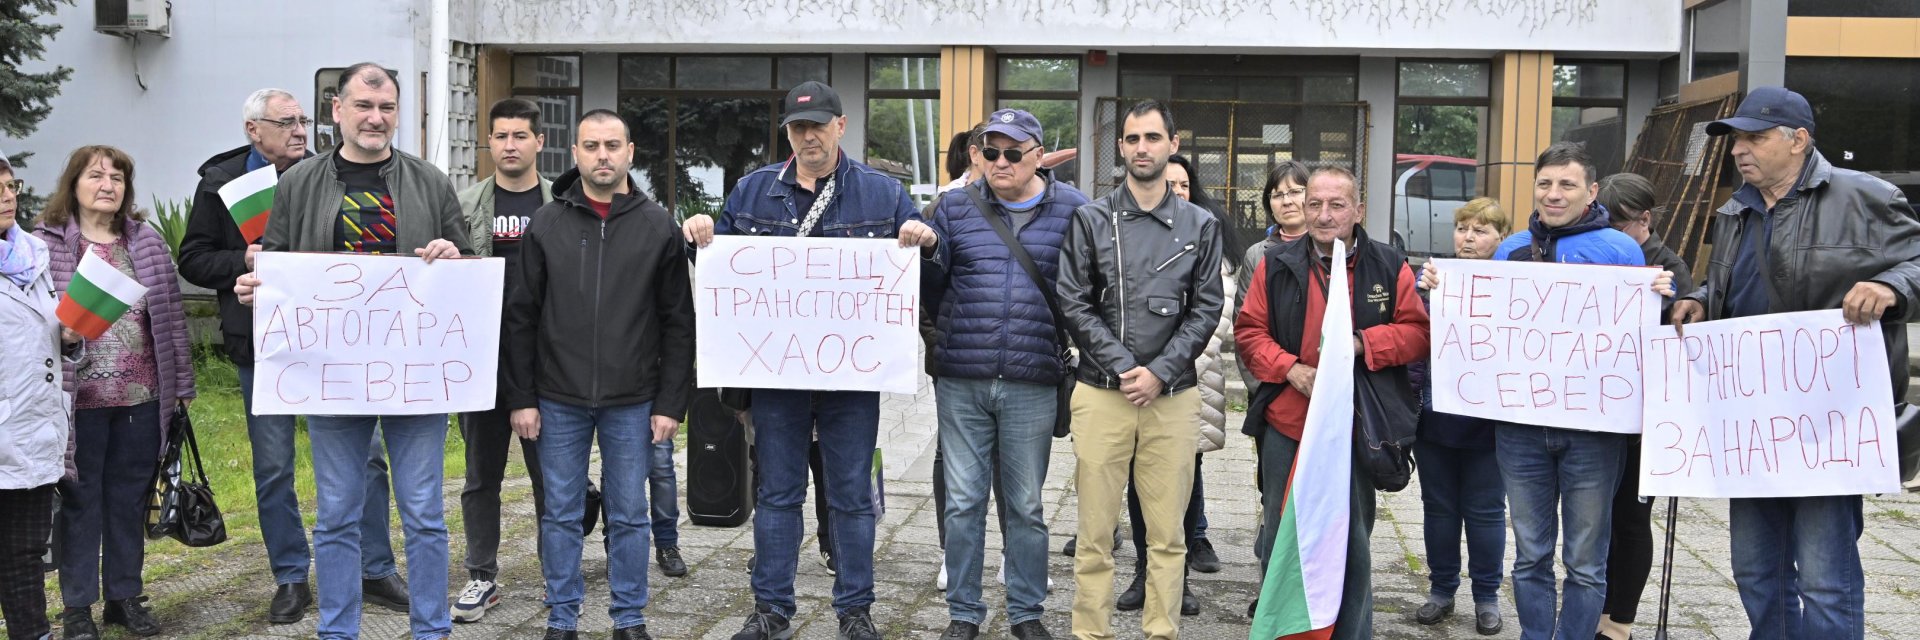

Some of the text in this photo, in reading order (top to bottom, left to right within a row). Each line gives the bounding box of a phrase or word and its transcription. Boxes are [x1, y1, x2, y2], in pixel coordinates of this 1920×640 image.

[313, 263, 424, 307] ЗА
[729, 245, 916, 292] СРЕЩУ
[260, 304, 468, 353] АВТОГАРА
[704, 286, 915, 327] ТРАНСПОРТЕН
[738, 331, 882, 376] ХАОС
[1438, 322, 1640, 372] АВТОГАРА
[1651, 324, 1872, 403] ТРАНСПОРТ
[276, 360, 473, 405] СЕВЕР
[1457, 371, 1634, 416] СЕВЕР
